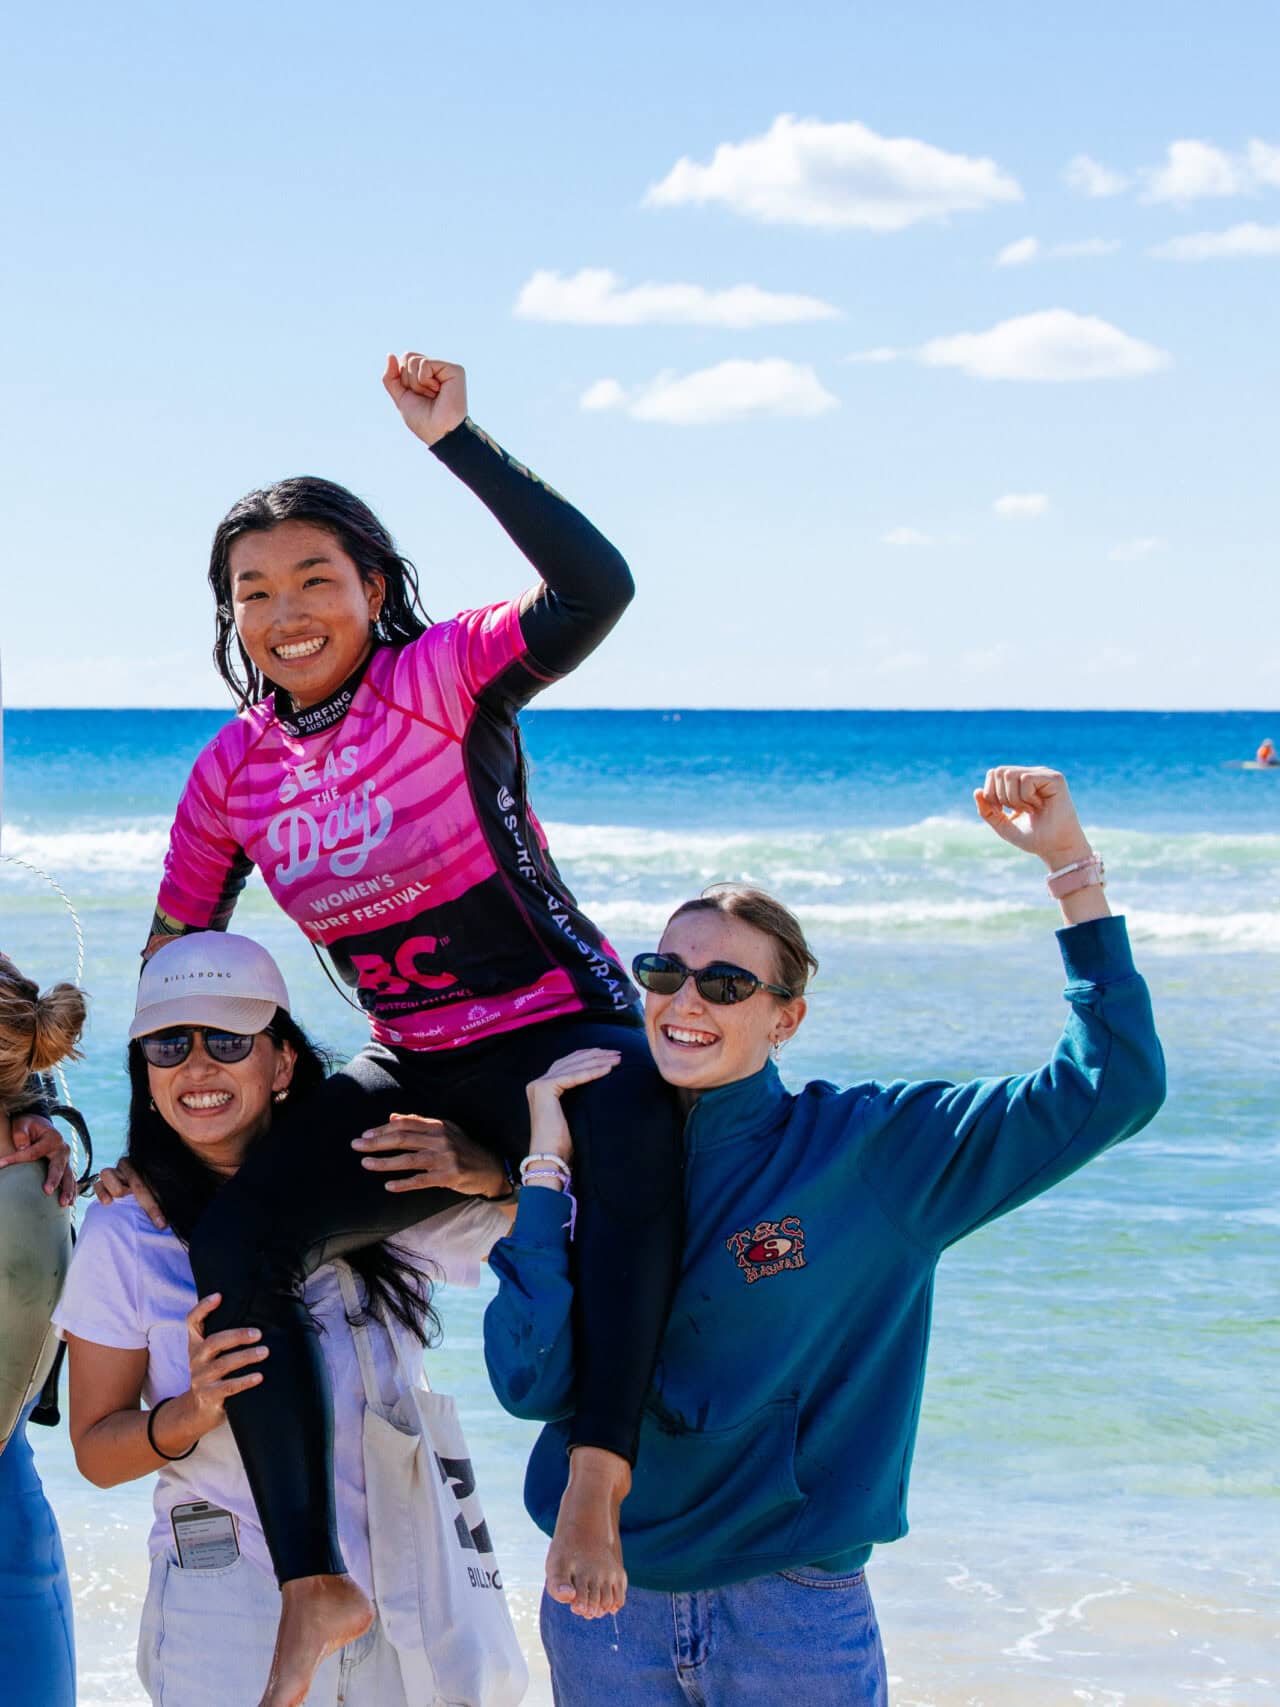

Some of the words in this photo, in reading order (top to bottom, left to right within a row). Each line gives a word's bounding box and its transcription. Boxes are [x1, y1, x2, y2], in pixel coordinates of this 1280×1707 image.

[297, 691, 352, 727] SURFING
[305, 703, 351, 733] AUSTRALIA
[279, 745, 359, 804] SEAS
[312, 786, 339, 808] THE
[267, 780, 394, 886] Day
[310, 874, 395, 913] WOMEN'S
[352, 881, 431, 921] FESTIVAL
[164, 971, 232, 984] BILLABONG
[350, 936, 460, 996] BC
[461, 1011, 501, 1031] SAMBAZON
[727, 1217, 804, 1258] T&C
